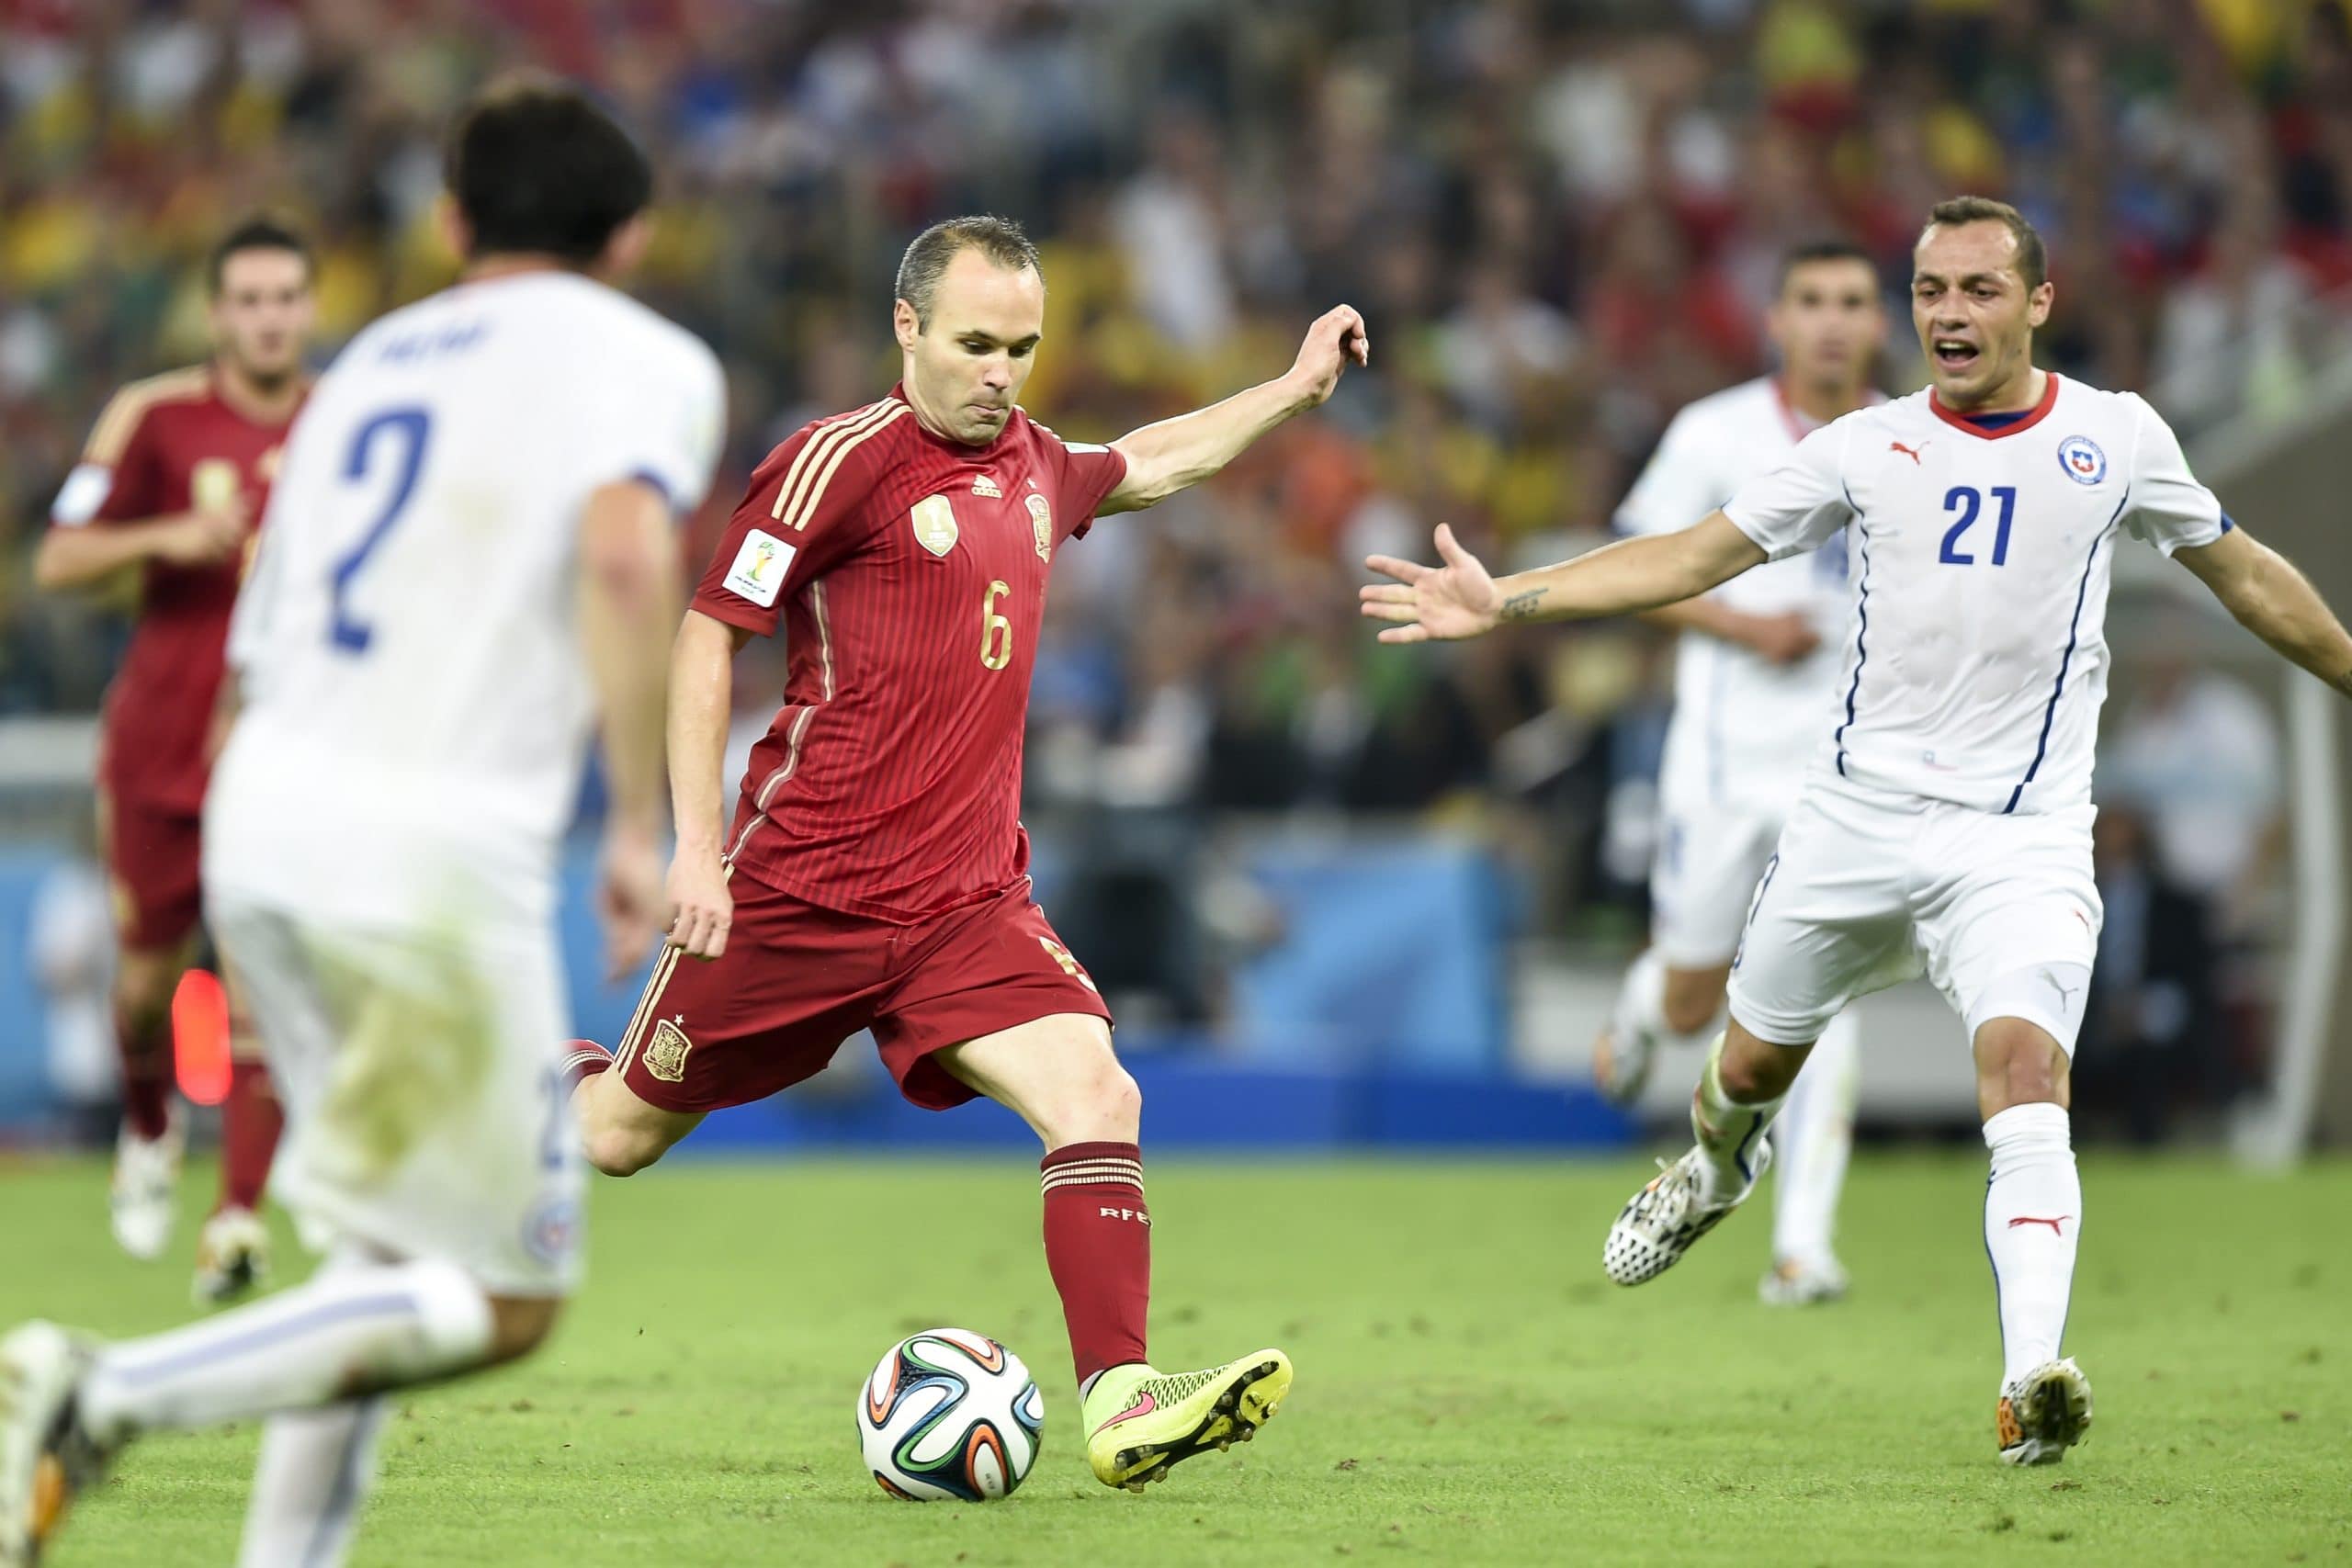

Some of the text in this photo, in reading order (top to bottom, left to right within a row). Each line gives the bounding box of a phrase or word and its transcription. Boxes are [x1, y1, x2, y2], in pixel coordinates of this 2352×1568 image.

[329, 400, 432, 653] 2
[1939, 485, 2017, 566] 21
[980, 580, 1012, 670] 6
